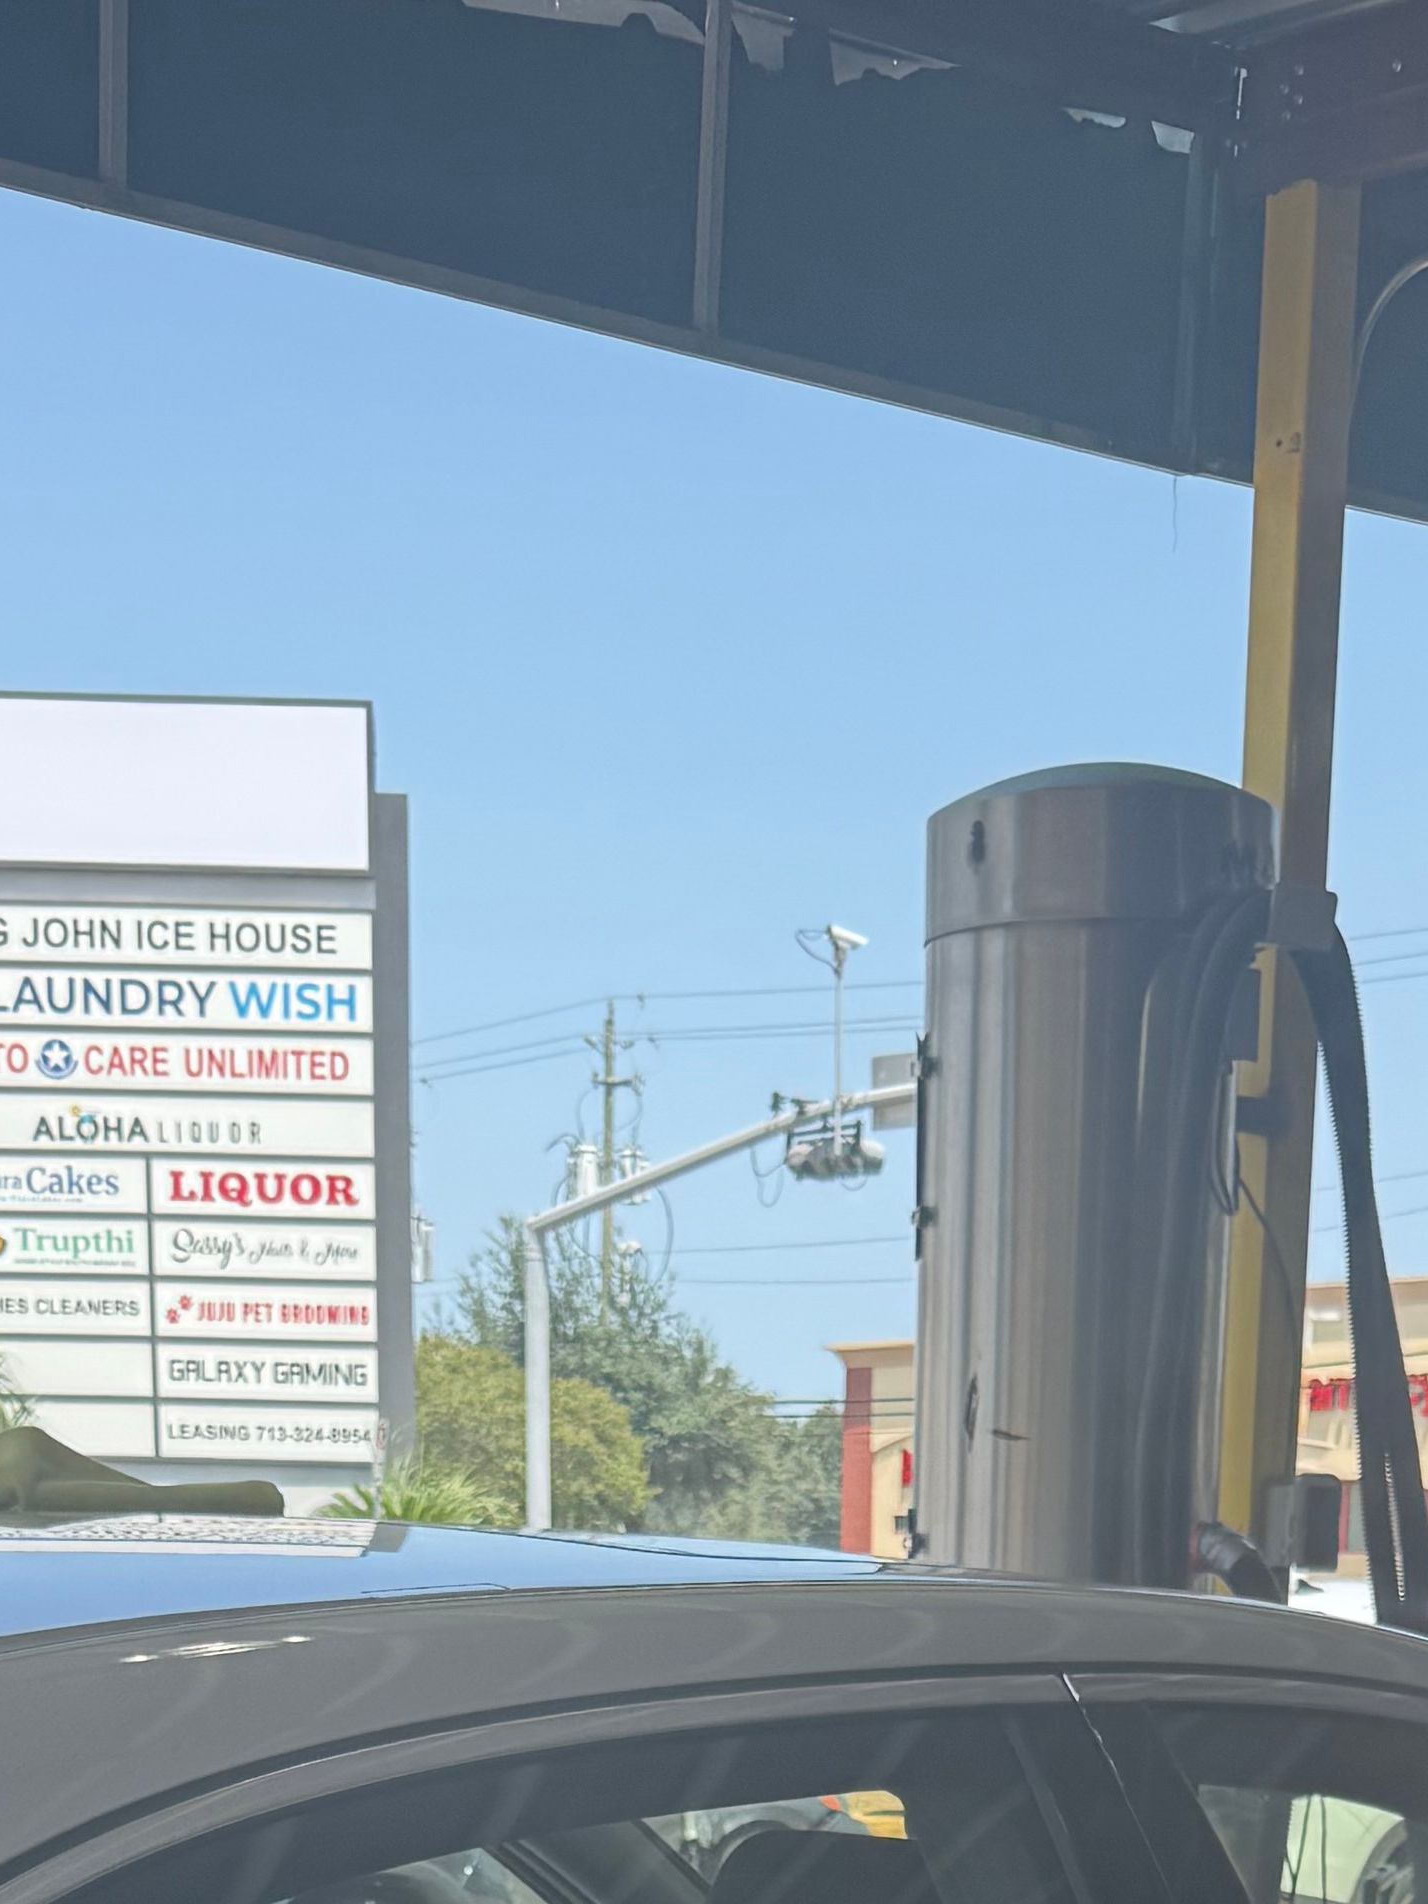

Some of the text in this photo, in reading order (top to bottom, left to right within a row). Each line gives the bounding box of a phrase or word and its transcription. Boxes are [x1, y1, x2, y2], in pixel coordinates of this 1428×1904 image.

[22, 917, 122, 951] JOHN
[136, 919, 195, 952] ICE
[209, 921, 339, 955] HOUSE
[228, 980, 358, 1022] WISH
[83, 1044, 170, 1077] CARE
[183, 1046, 350, 1081] UNLIMITED
[32, 1115, 262, 1144] ALOHA LIQUOR
[26, 1164, 120, 1196] Cakes
[168, 1170, 360, 1207] LIQUOR
[12, 1226, 136, 1259] Trupthi
[171, 1227, 246, 1270] Sassy's
[35, 1298, 141, 1317] CLEANERS
[197, 1301, 370, 1326] JUJU PET GROOMING
[168, 1358, 368, 1387] GALAXY GAMING
[167, 1423, 251, 1442] LEASING
